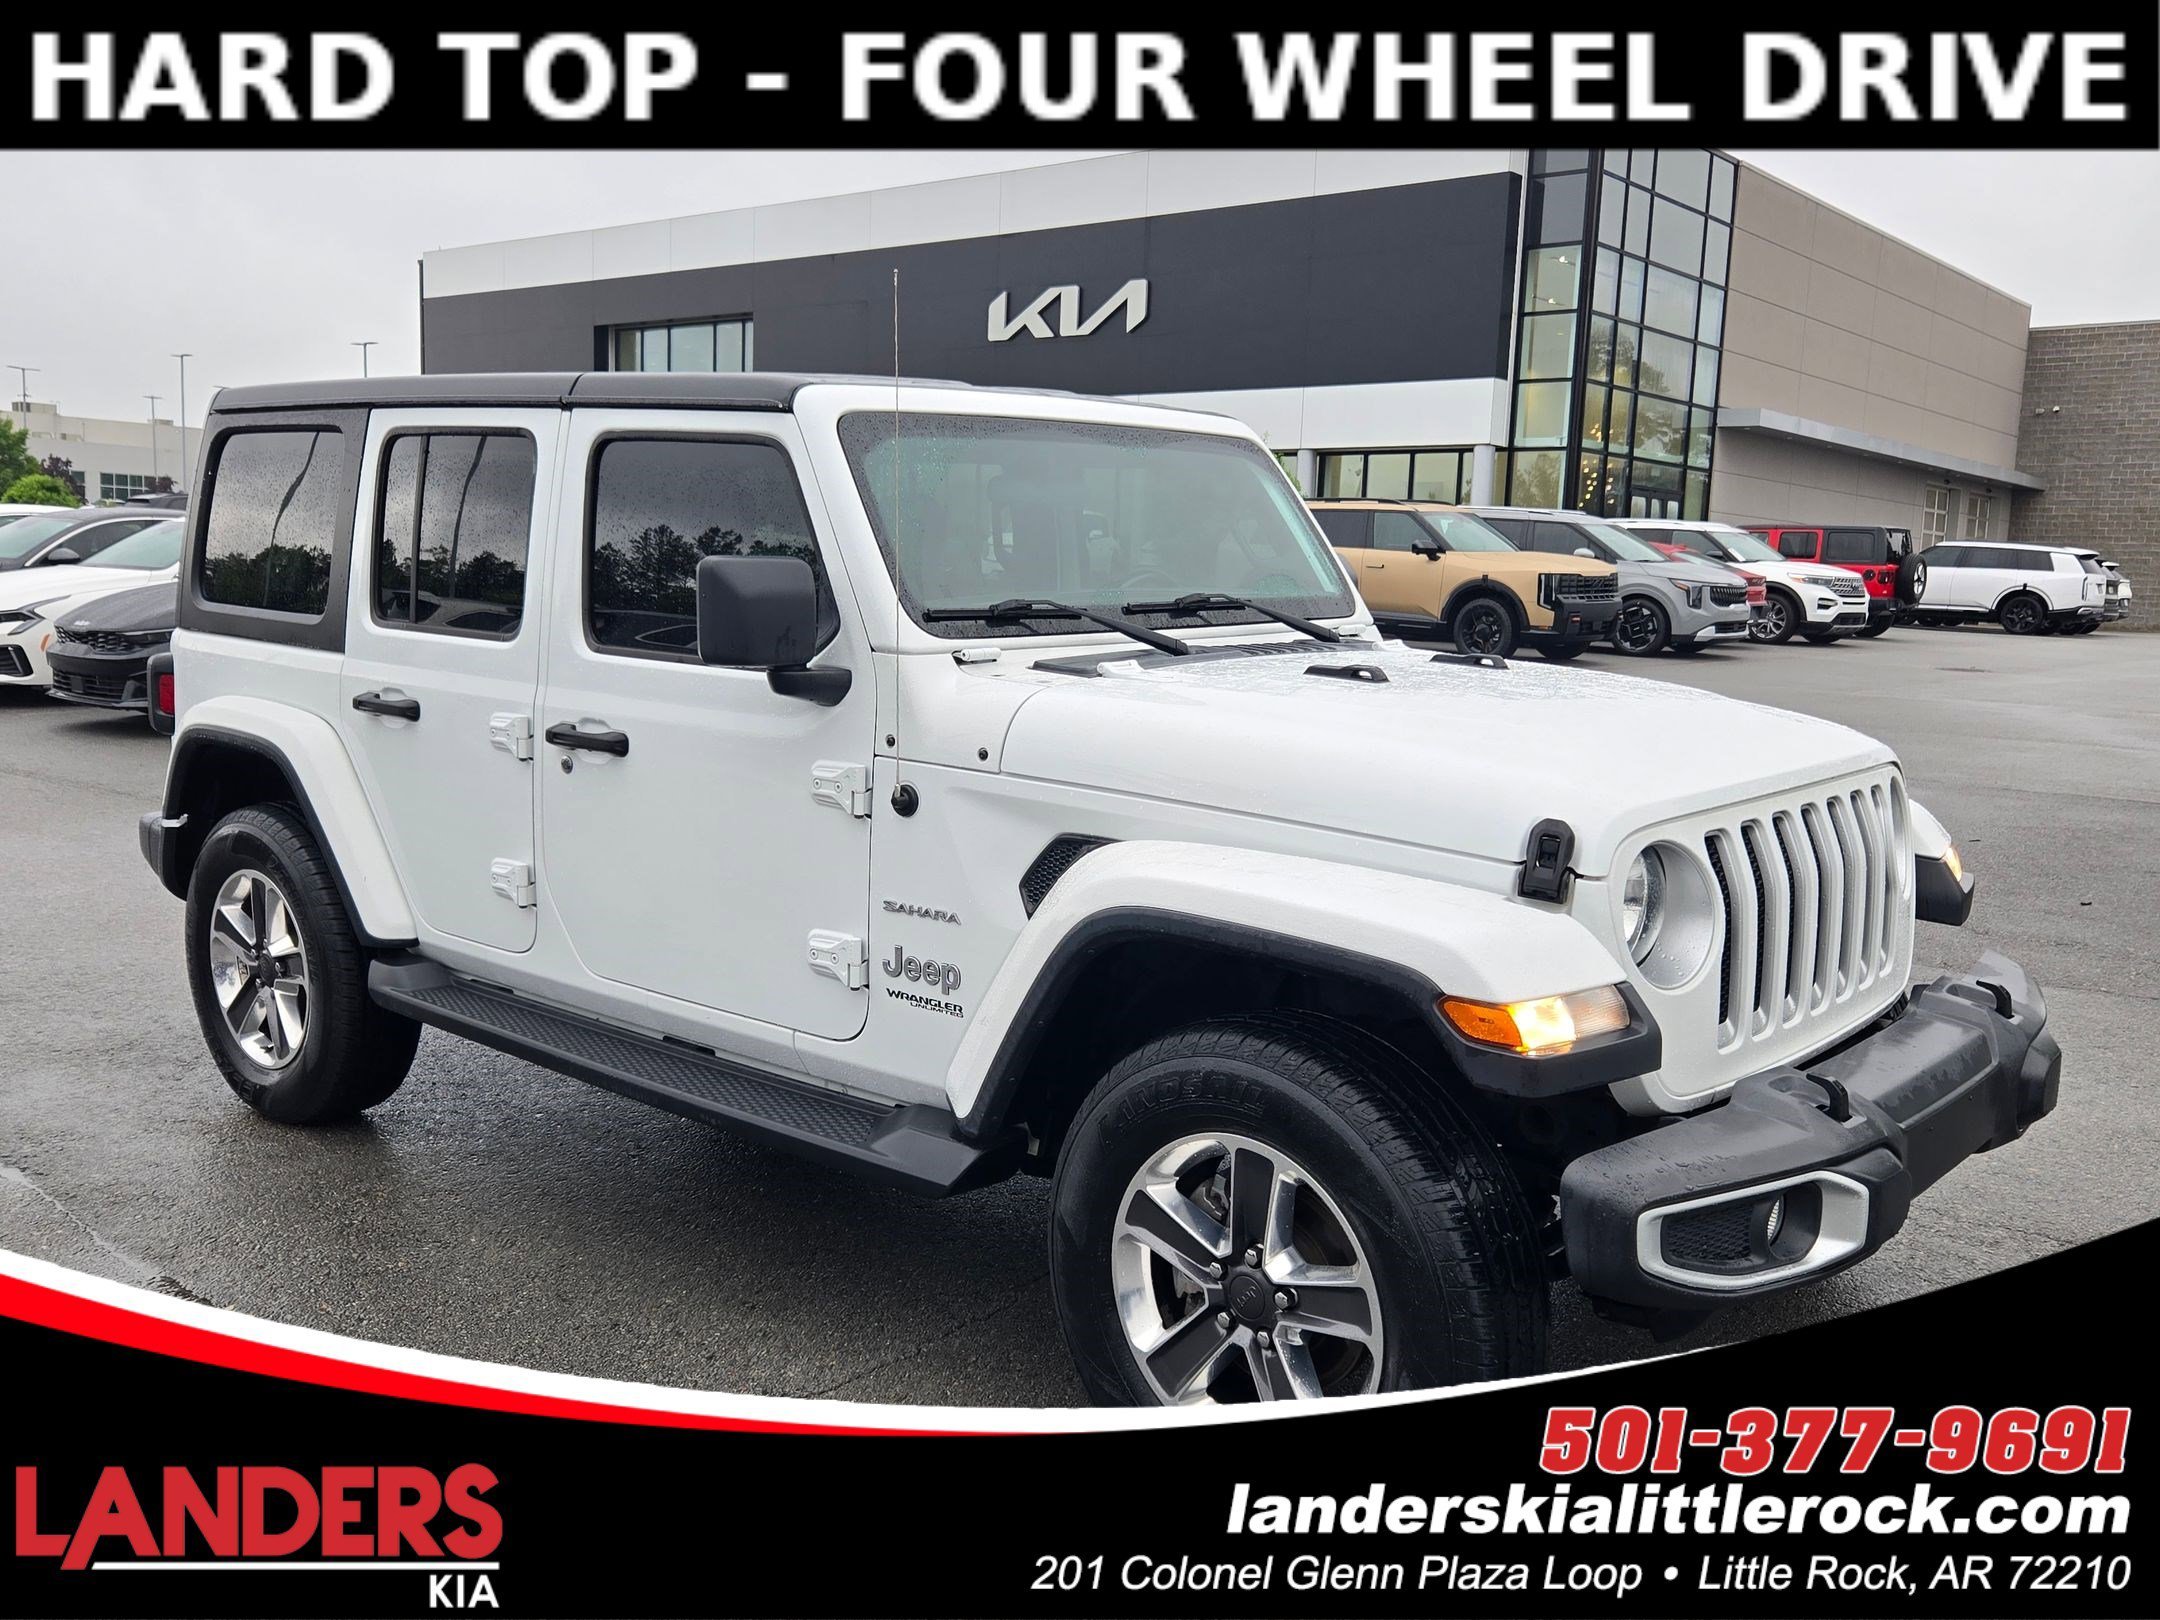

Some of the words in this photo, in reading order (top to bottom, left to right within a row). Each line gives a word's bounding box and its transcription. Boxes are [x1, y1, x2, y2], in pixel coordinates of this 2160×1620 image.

[987, 278, 1149, 342] KIA
[882, 900, 962, 925] SAHARA
[882, 944, 962, 996] Jeep
[886, 987, 964, 1014] WRANGLER
[909, 1001, 965, 1019] UNLIMITED
